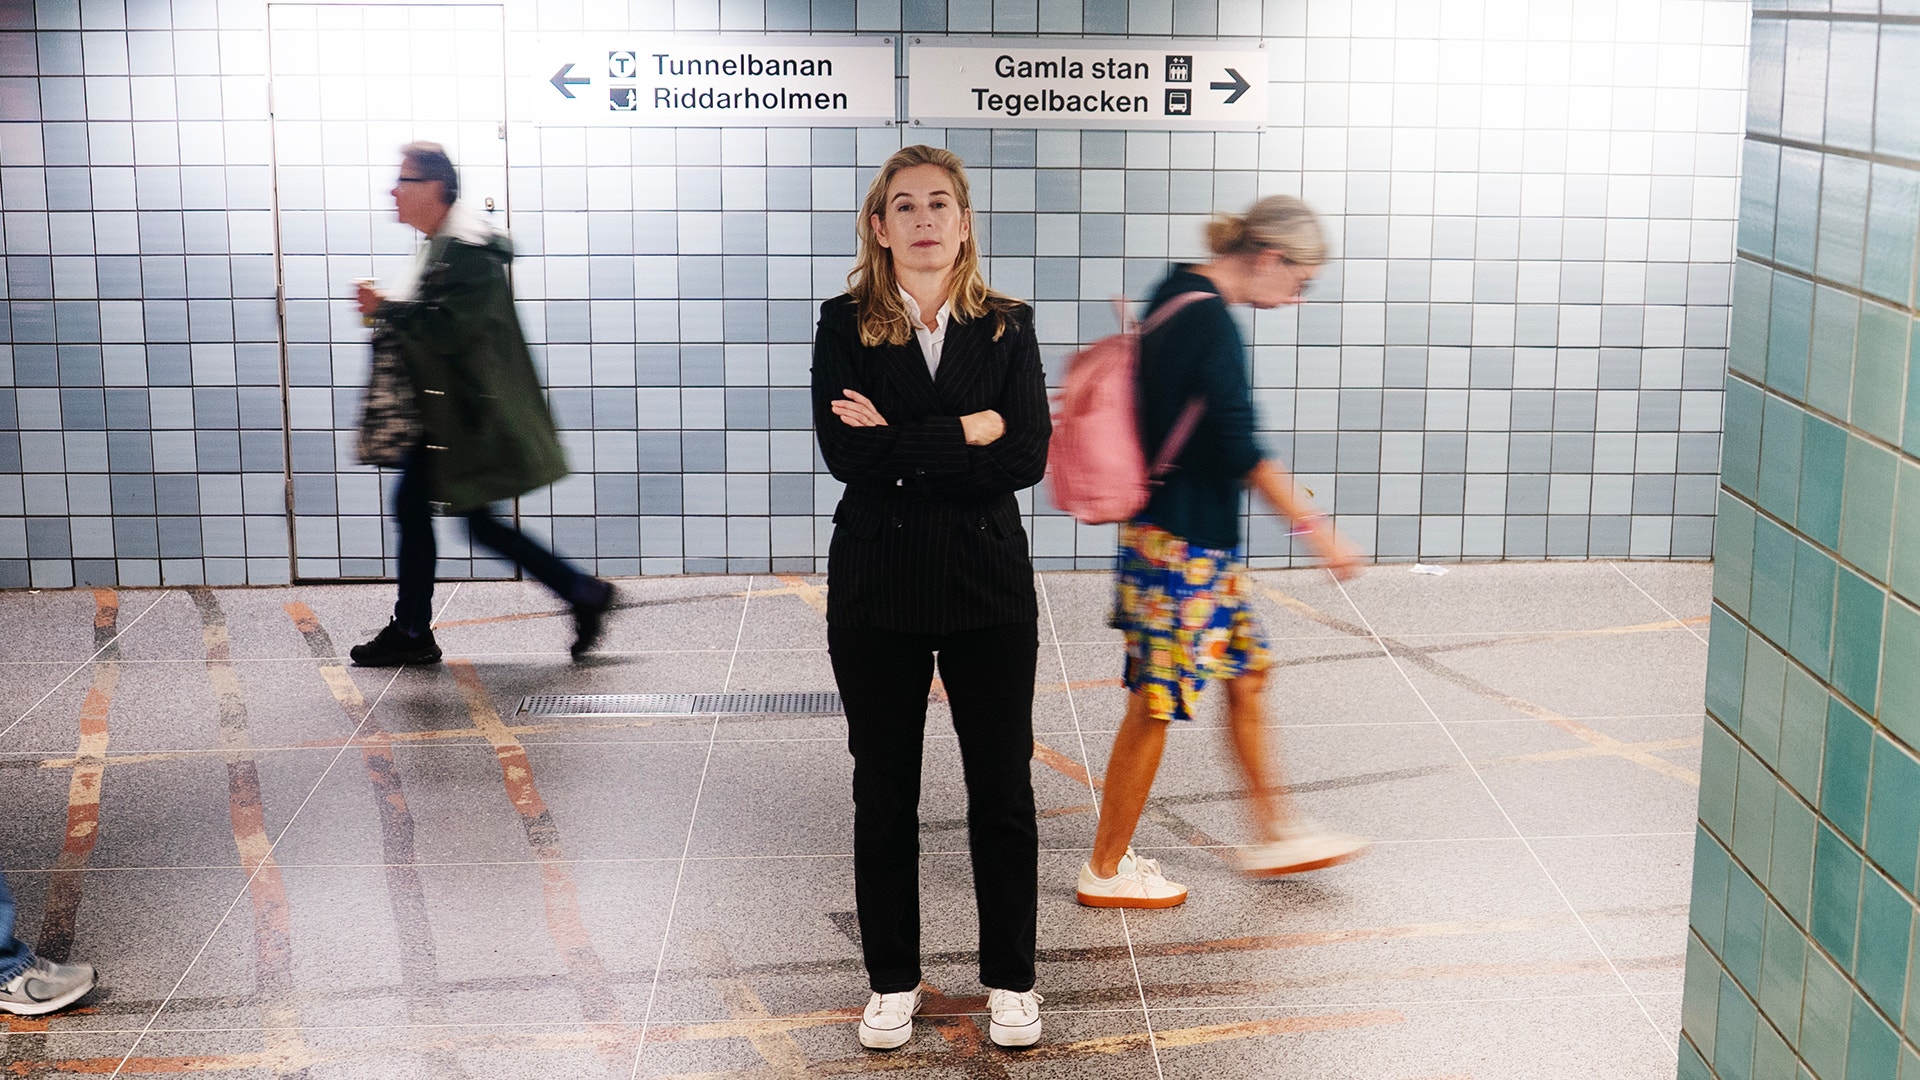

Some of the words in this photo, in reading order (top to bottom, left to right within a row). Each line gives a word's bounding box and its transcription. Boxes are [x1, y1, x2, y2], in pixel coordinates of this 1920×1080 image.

[652, 54, 833, 76] Tunnelbanan
[994, 55, 1084, 79] Gamla
[1091, 57, 1149, 80] stan
[653, 87, 848, 110] Riddarholmen
[971, 88, 1148, 117] Tegelbacken
